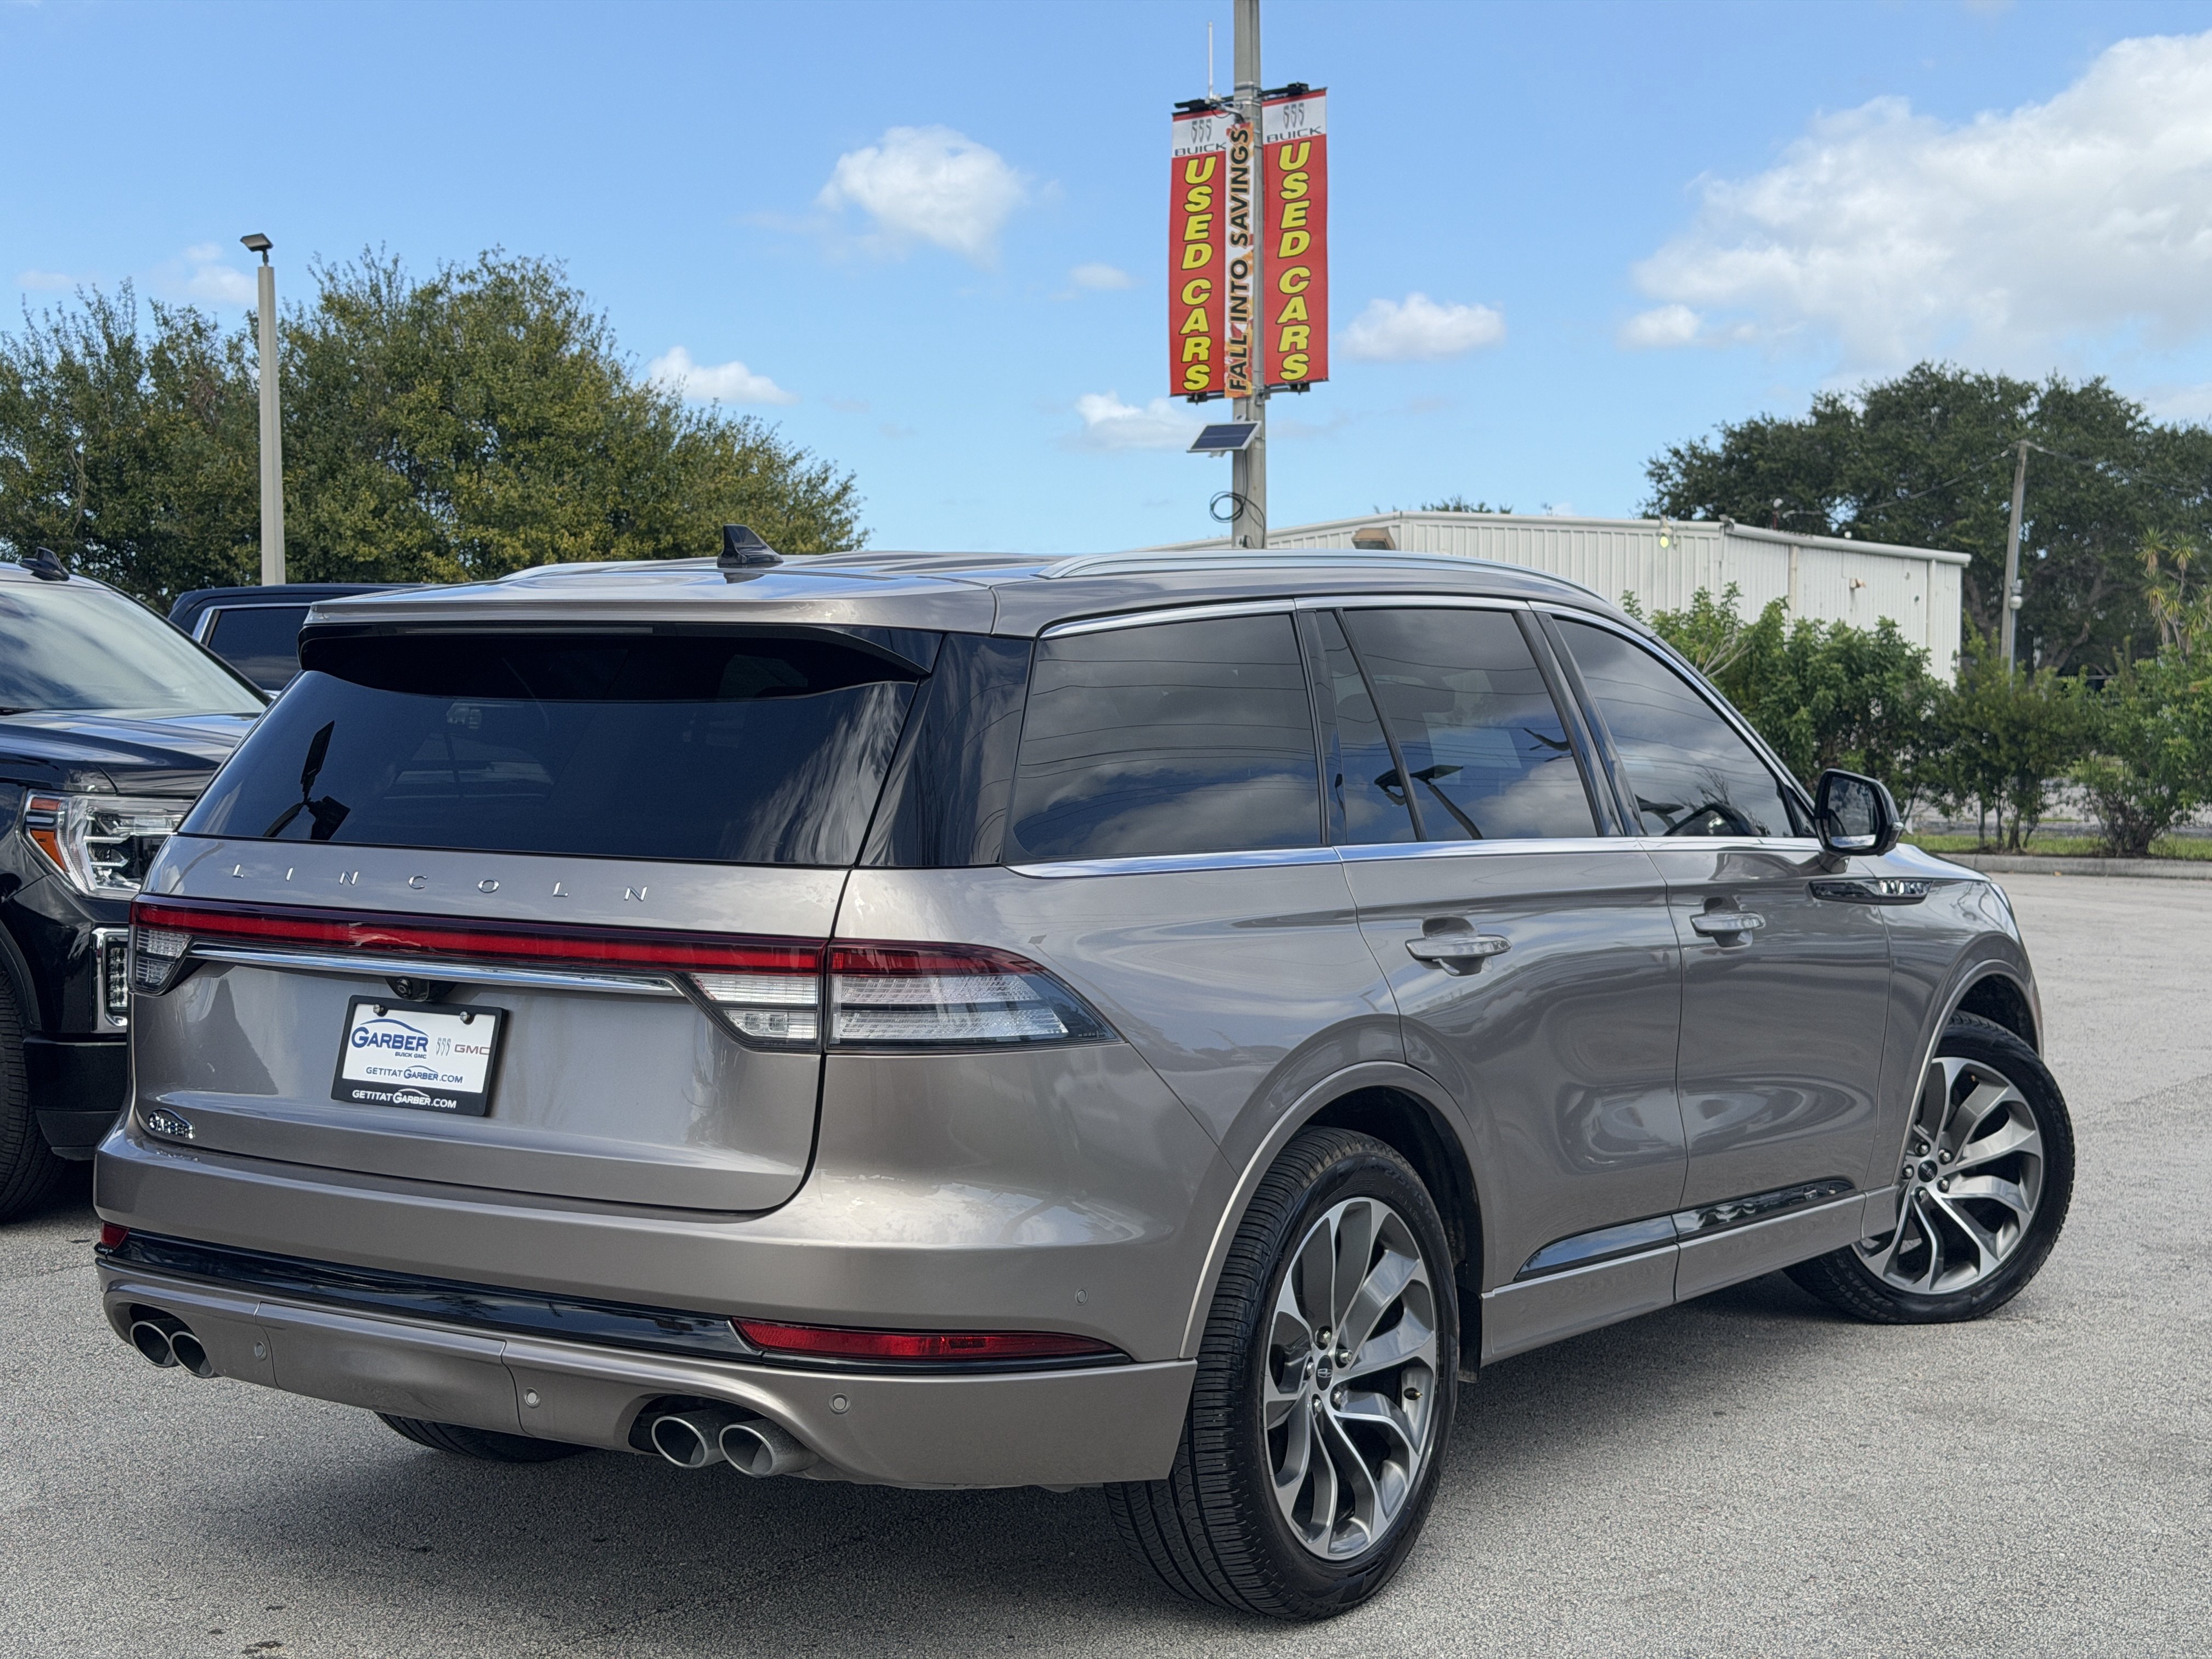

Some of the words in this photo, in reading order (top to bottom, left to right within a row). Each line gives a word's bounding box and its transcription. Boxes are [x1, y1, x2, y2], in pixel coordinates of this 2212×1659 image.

[1181, 155, 1217, 270] USED
[1229, 128, 1251, 248] SAVINGS
[1277, 140, 1312, 259] USED
[1228, 258, 1249, 323] INTO
[1178, 277, 1212, 391] CARS
[1276, 265, 1311, 381] CARS
[1228, 332, 1249, 392] FALL
[232, 864, 649, 902] LINCOLN
[351, 1026, 429, 1052] GARBER
[454, 1043, 490, 1056] GMC
[352, 1089, 457, 1109] GETITATGARBER.COM
[365, 1066, 463, 1084] GETITATGARBER.COM
